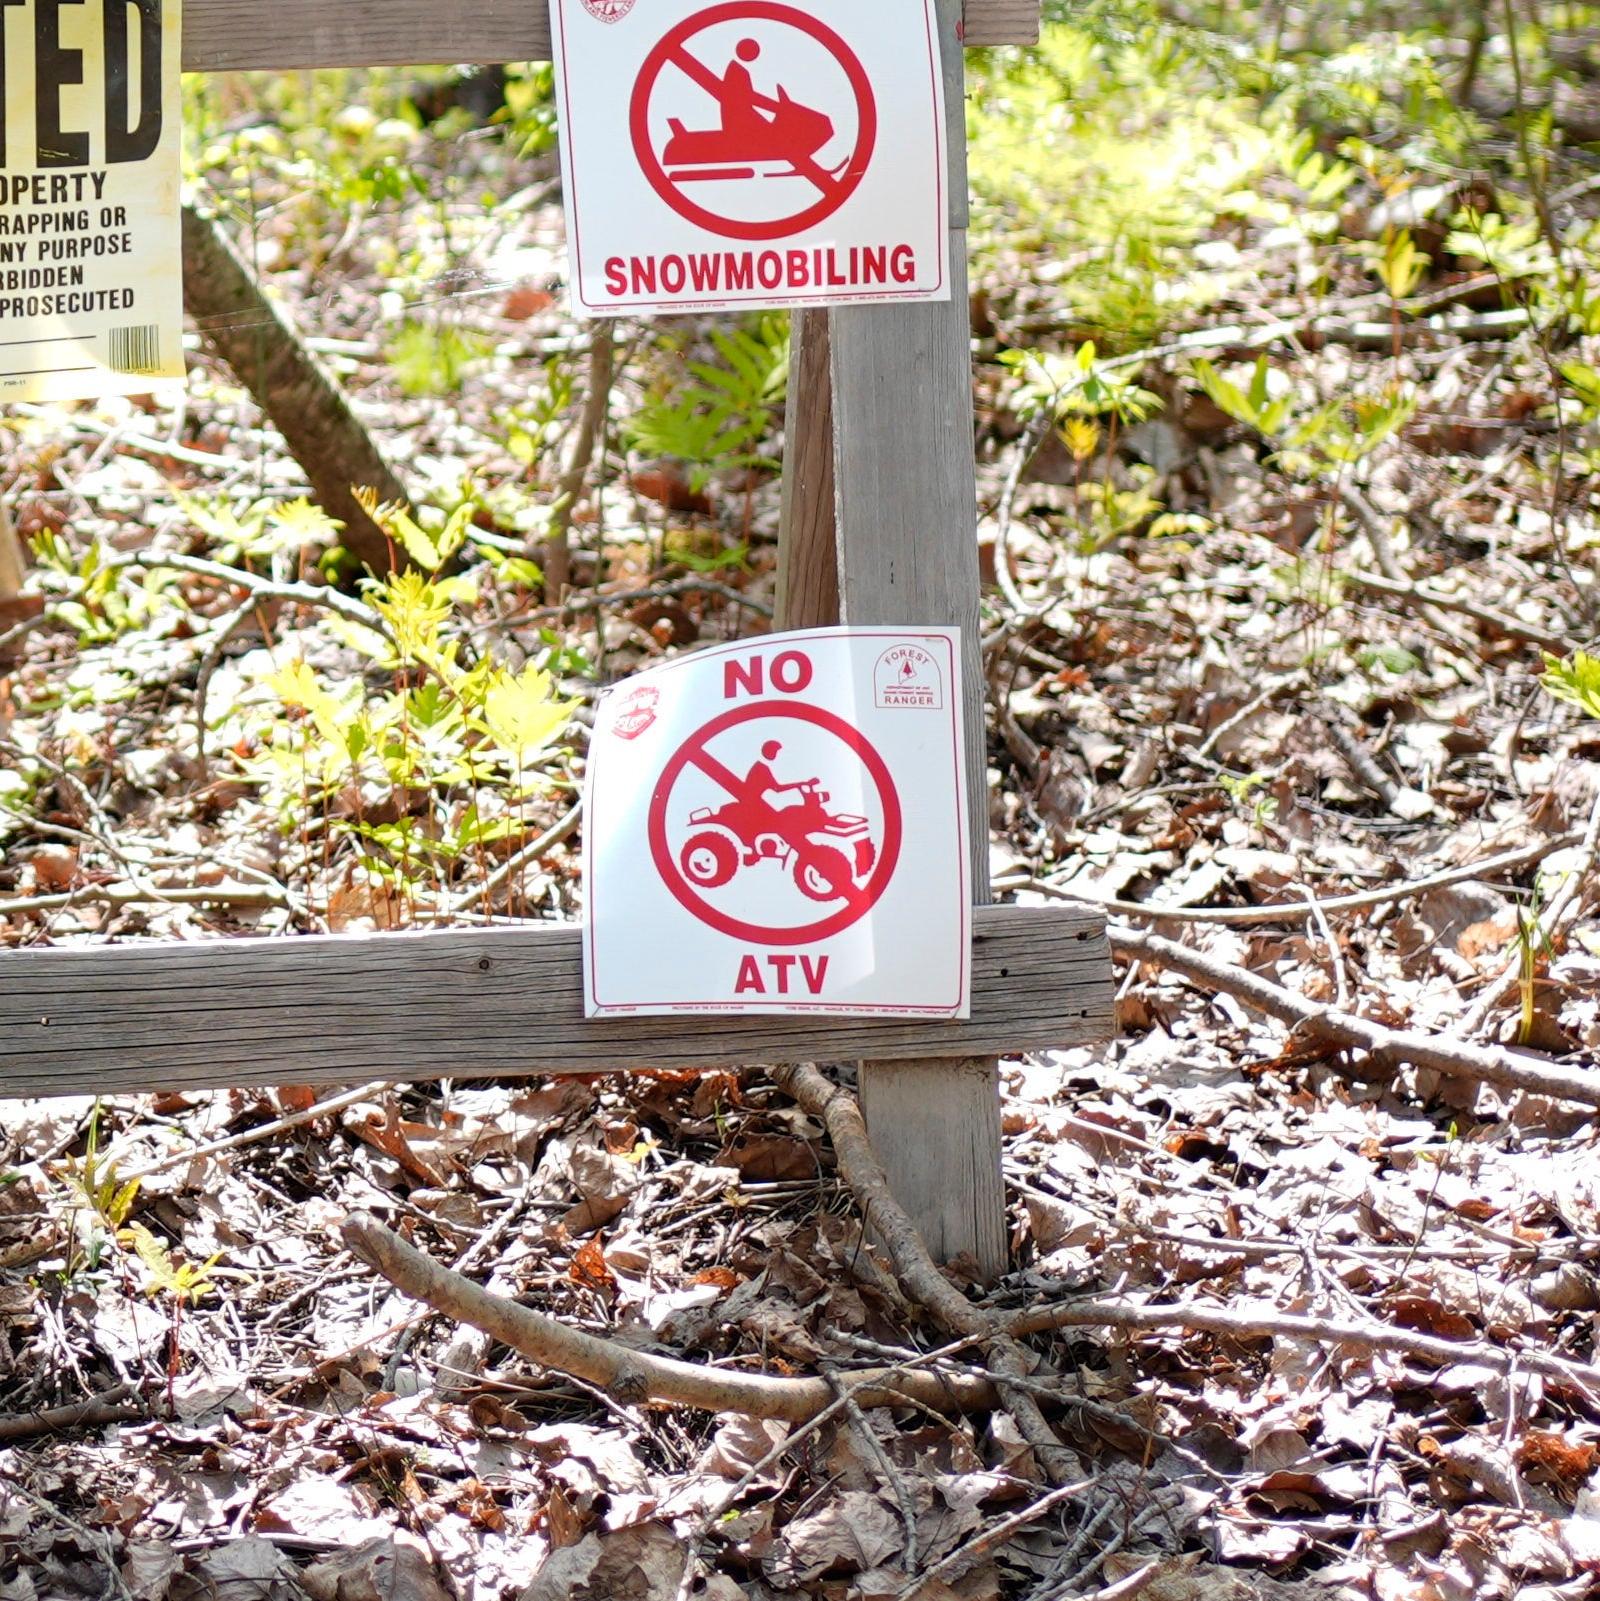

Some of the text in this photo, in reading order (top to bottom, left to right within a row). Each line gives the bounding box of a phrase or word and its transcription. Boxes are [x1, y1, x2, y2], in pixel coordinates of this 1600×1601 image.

[100, 206, 127, 228] OR
[38, 232, 132, 261] PURPOSE
[604, 244, 916, 297] SNOWMOBILING
[884, 649, 930, 666] FOREST
[723, 650, 813, 700] NO
[884, 696, 934, 705] RANGER
[734, 954, 829, 995] ATV
